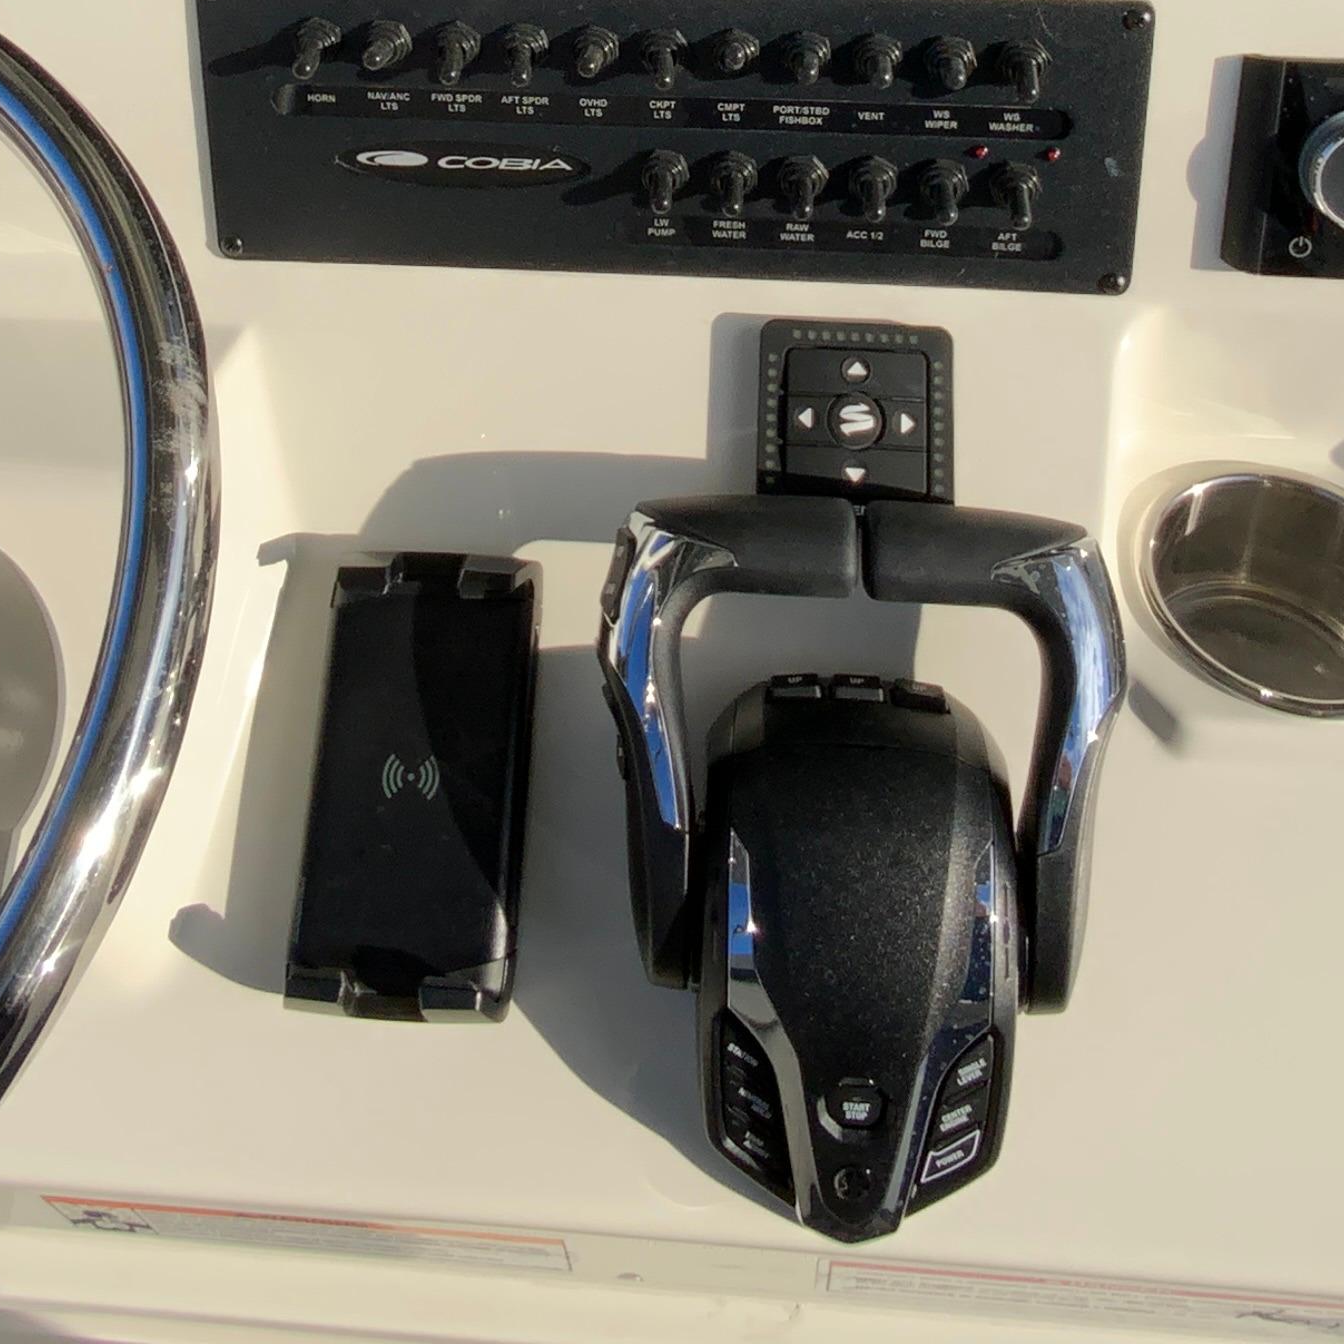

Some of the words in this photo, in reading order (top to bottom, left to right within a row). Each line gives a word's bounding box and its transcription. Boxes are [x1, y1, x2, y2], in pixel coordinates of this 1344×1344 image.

[307, 94, 336, 103] HORN
[431, 93, 454, 102] FWD
[456, 94, 482, 104] SPDR
[501, 96, 520, 105] AFT
[522, 97, 549, 107] SPDR
[579, 98, 608, 108] OVHD
[381, 102, 398, 111] LTS
[448, 103, 466, 112] LTS
[516, 105, 534, 114] LTS
[649, 100, 676, 110] CKPT
[717, 103, 745, 113] CMPT
[584, 108, 602, 117] LTS
[653, 110, 672, 119] LTS
[773, 105, 830, 116] PORT/STBD
[933, 110, 950, 119] WS
[722, 113, 740, 122] LTS
[779, 115, 823, 126] FISHBOX
[858, 112, 885, 122] VENT
[1003, 113, 1020, 122] WS
[925, 119, 957, 129] WIPER
[989, 122, 1033, 133] WASHER
[438, 156, 573, 172] COBIA
[654, 218, 669, 227] LW
[713, 220, 746, 230] FRESH
[786, 223, 810, 232] RAW
[648, 227, 675, 237] PUMP
[712, 230, 746, 240] WATER
[780, 232, 815, 242] WATER
[847, 230, 868, 240] ACC
[924, 230, 947, 239] FWD
[998, 233, 1017, 242] AFT
[920, 239, 949, 249] BILGE
[992, 242, 1022, 252] BILGE
[842, 1101, 871, 1112] START
